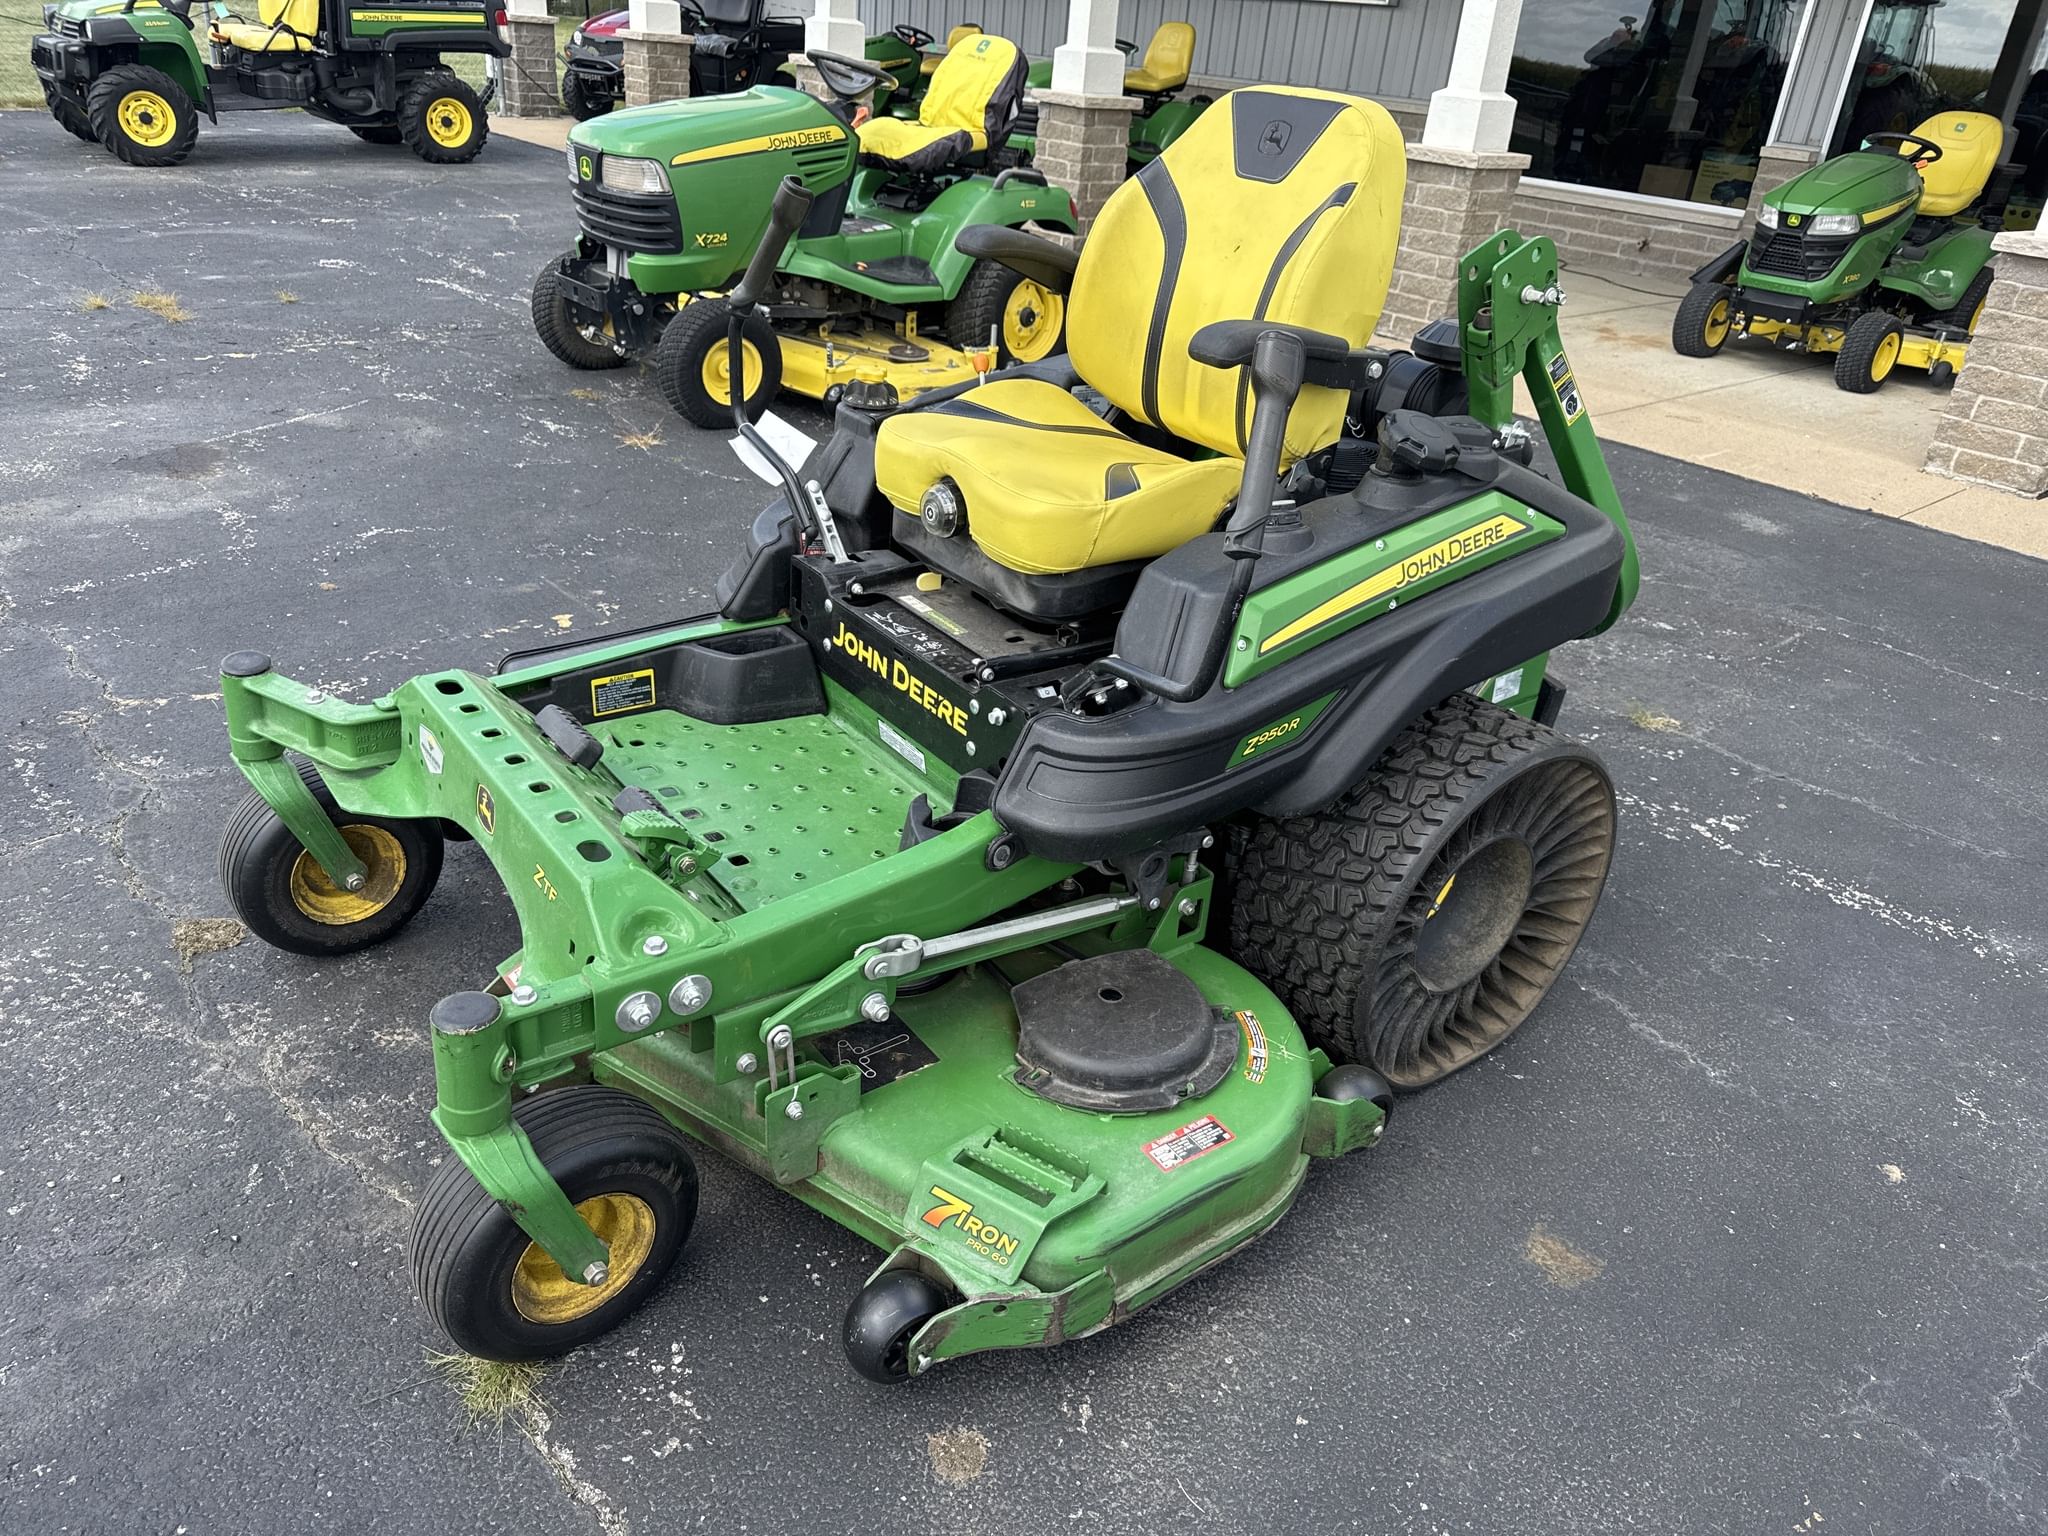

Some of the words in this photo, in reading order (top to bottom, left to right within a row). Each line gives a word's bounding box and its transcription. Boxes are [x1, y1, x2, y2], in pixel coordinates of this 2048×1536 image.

[767, 135, 797, 149] JOHN
[797, 130, 833, 145] DEERE
[695, 232, 728, 247] X724
[1396, 548, 1446, 586] JOHN
[1448, 522, 1505, 561] DEERE
[832, 621, 888, 680] JOHN
[892, 659, 969, 737] DEERE
[1242, 716, 1302, 756] Z950R
[533, 863, 558, 901] ZTF
[965, 1237, 990, 1256] PRO
[991, 1252, 1009, 1266] 60
